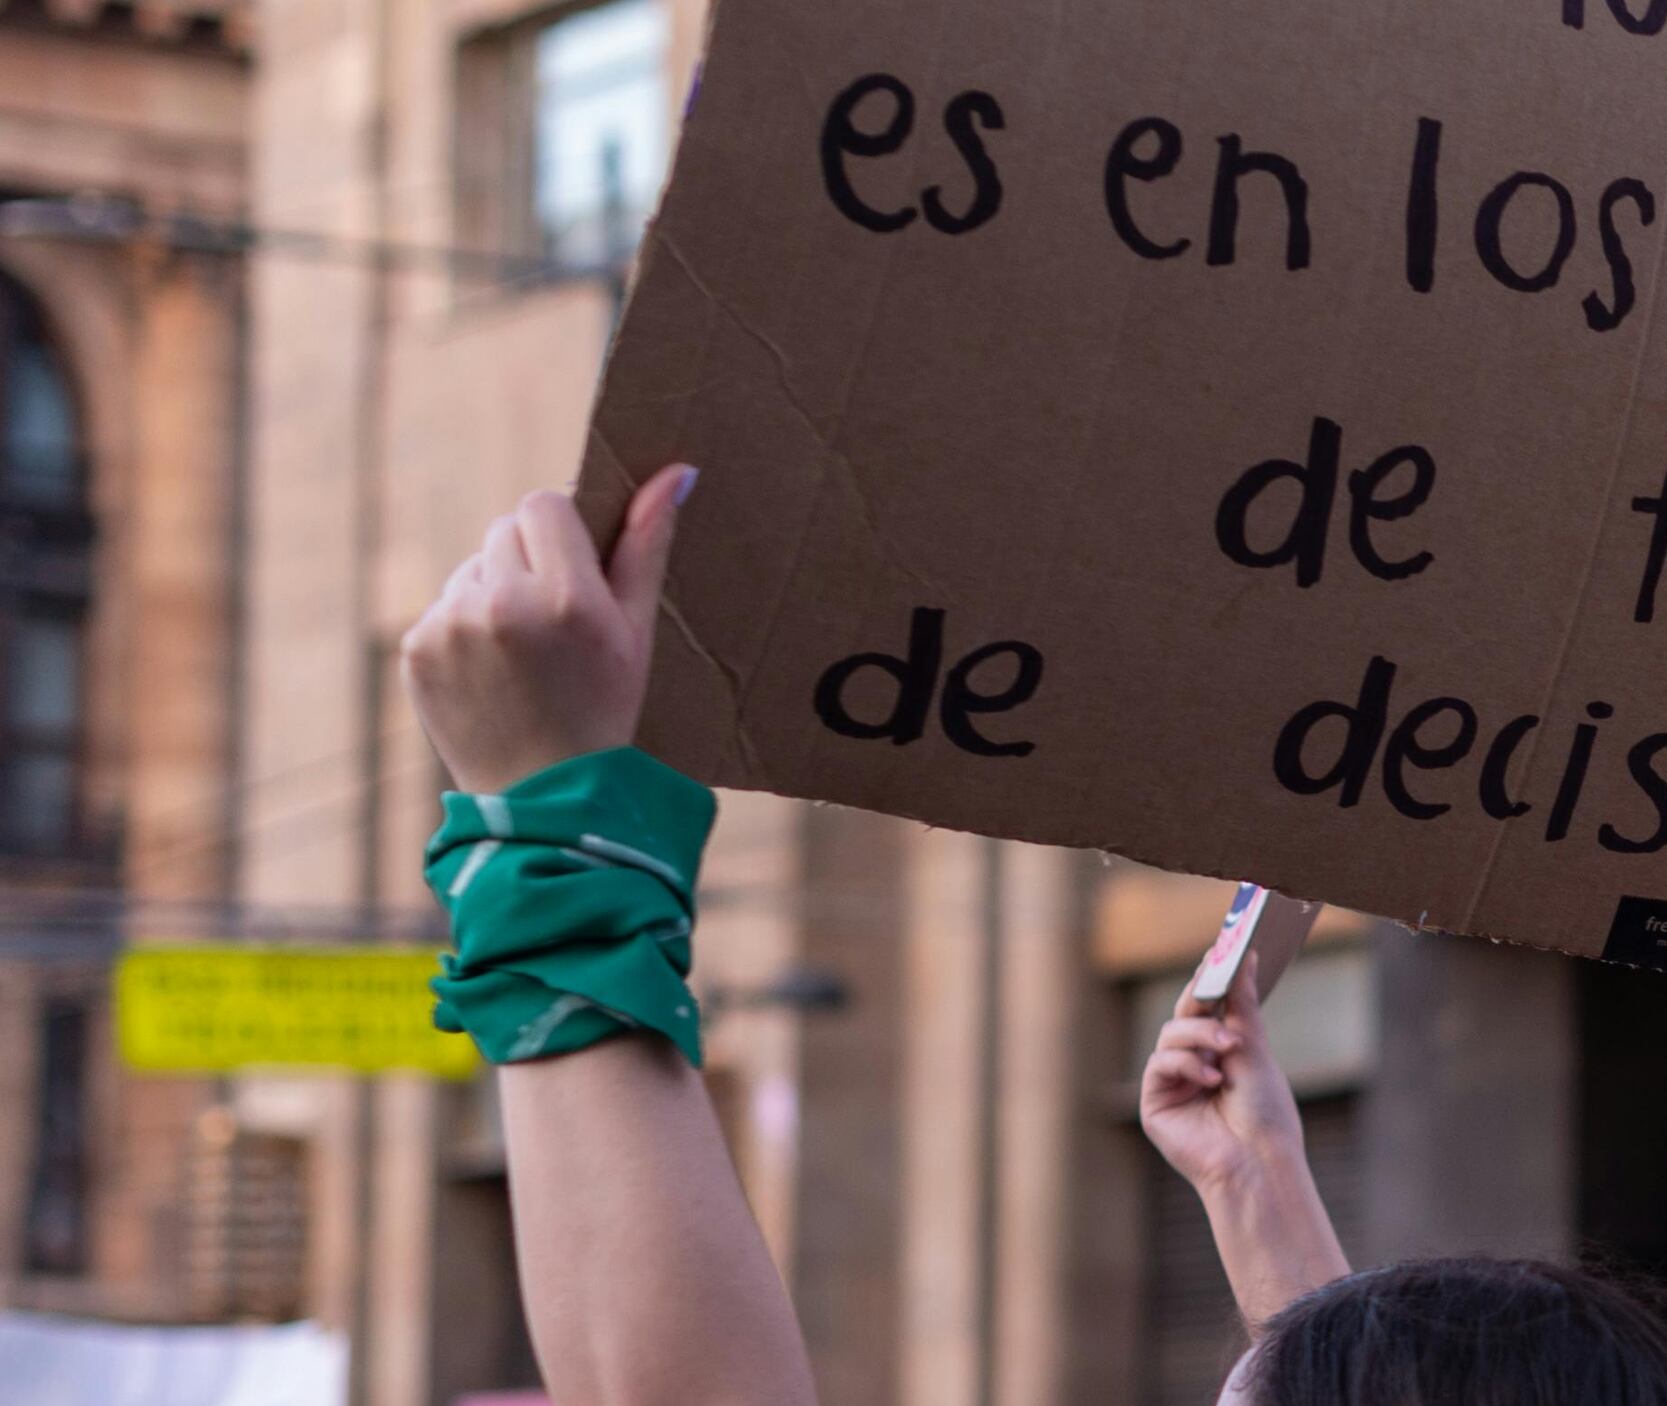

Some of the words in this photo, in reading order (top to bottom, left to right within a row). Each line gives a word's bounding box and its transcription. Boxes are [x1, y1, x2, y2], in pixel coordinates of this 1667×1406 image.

[817, 72, 1007, 237] es
[1103, 117, 1312, 272] en
[1406, 117, 1656, 332] los
[1213, 415, 1438, 590] de
[813, 605, 1044, 758] de
